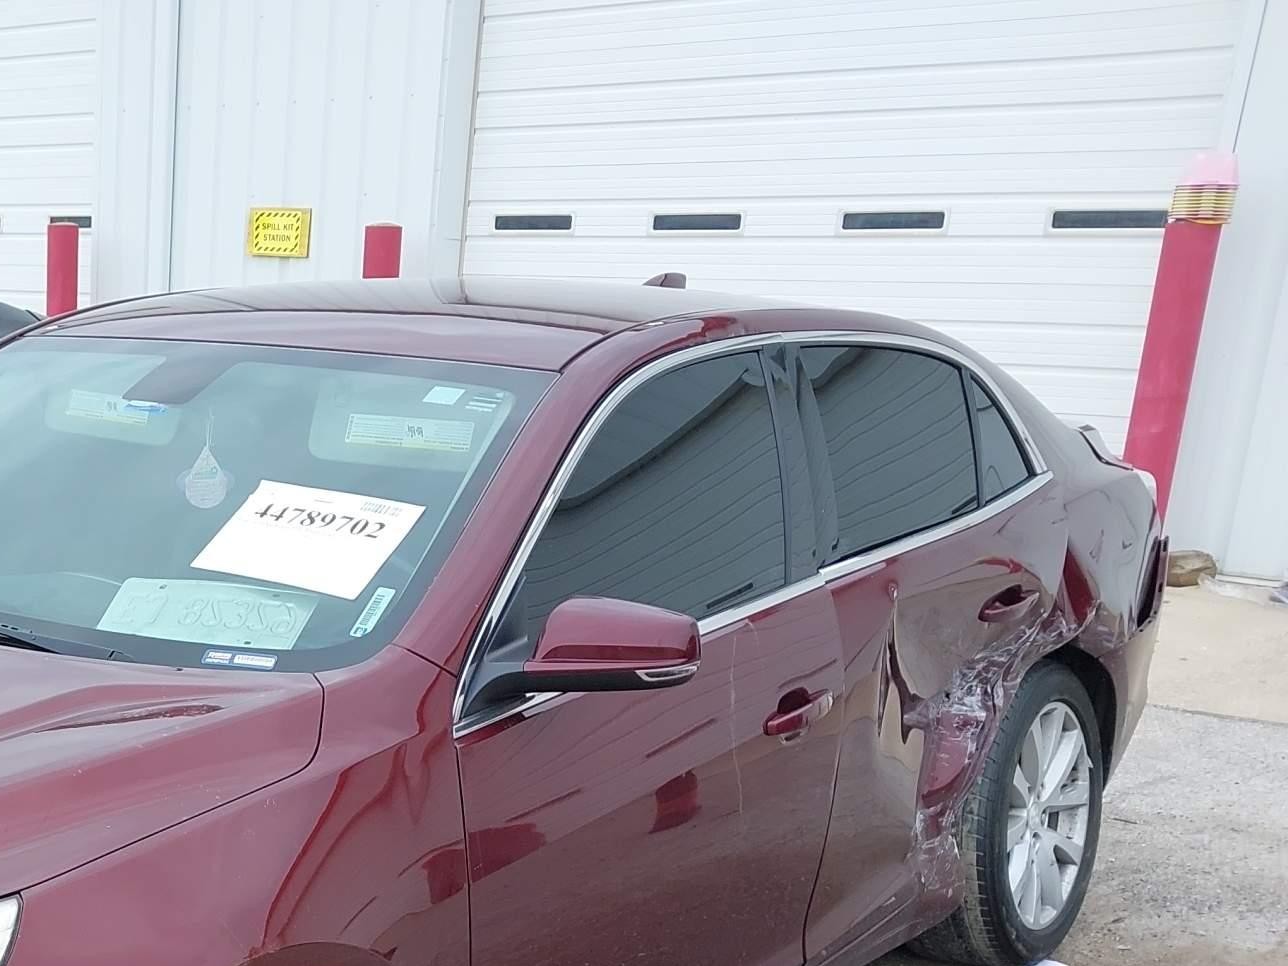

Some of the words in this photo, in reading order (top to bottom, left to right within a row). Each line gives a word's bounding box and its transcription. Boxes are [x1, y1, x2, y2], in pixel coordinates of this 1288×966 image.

[261, 222, 280, 231] SPILL
[283, 223, 294, 231] KIT
[263, 233, 291, 242] STATION
[254, 503, 386, 539] 44789702
